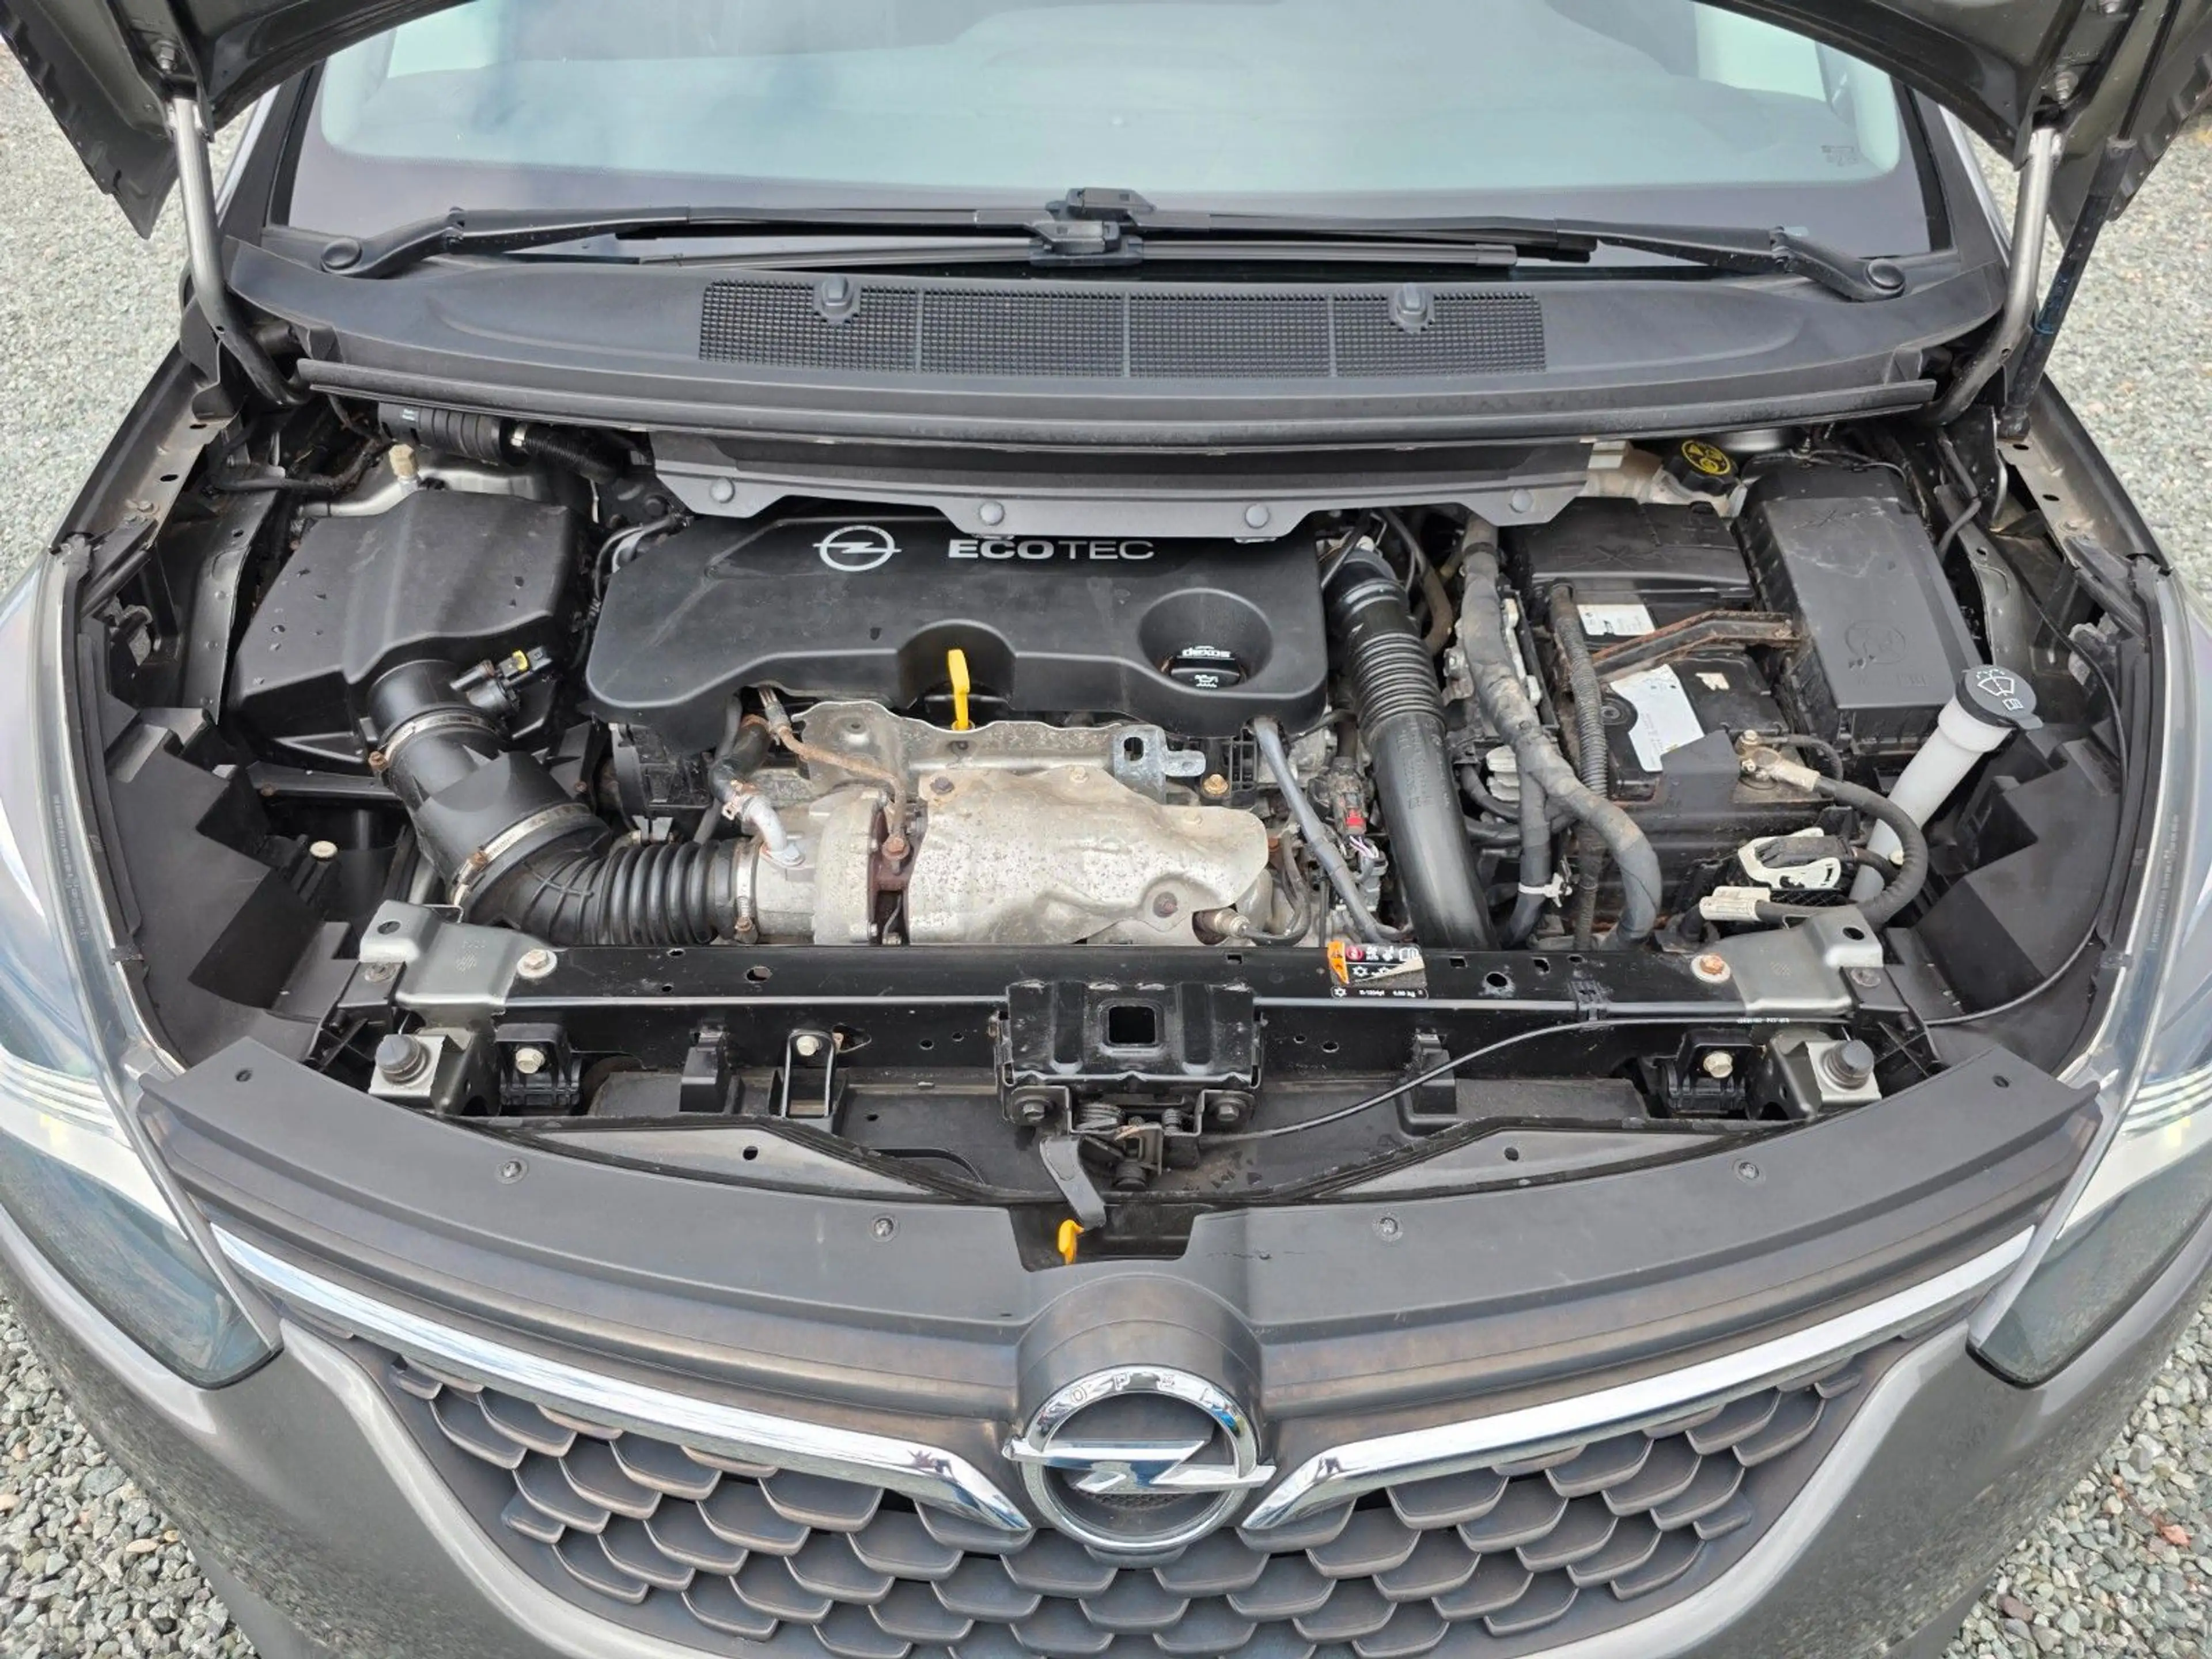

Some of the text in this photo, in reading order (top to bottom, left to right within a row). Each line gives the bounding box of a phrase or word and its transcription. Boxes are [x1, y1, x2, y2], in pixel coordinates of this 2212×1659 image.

[948, 539, 1154, 560] ECOTEC
[1182, 647, 1231, 658] dexos
[1071, 1371, 1212, 1406] OPEL
